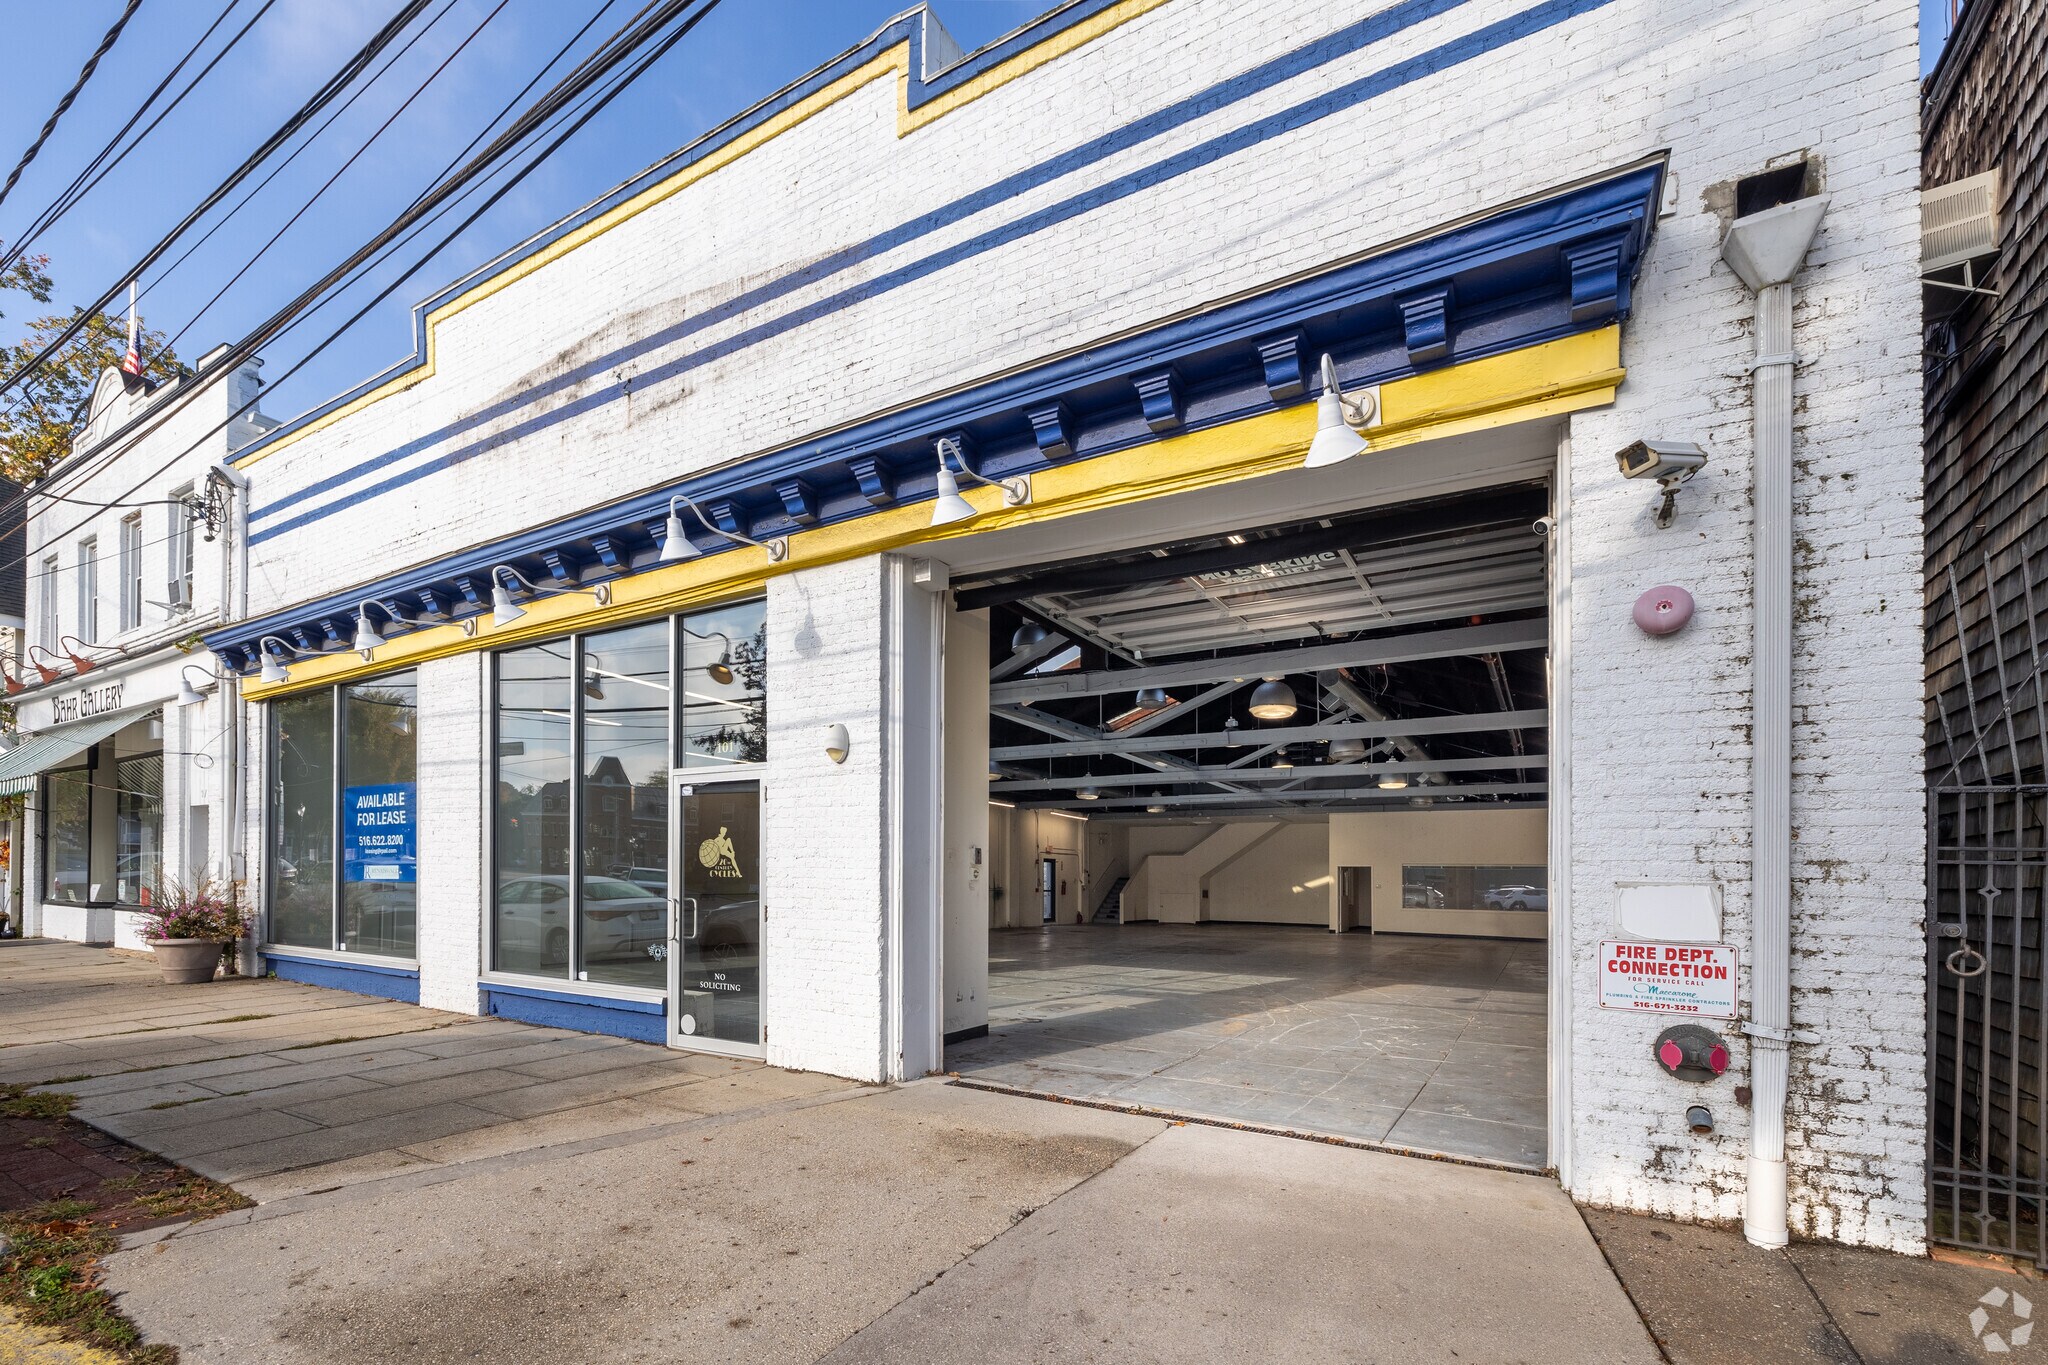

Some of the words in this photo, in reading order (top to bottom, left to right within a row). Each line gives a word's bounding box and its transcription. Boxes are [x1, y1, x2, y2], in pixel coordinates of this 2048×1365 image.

[81, 684, 123, 717] GALLERY
[717, 741, 734, 754] 101
[357, 792, 405, 809] AVAILABLE
[357, 812, 375, 826] FOR
[377, 811, 406, 825] LEASE
[358, 835, 403, 846] 516.622.8200
[1616, 945, 1656, 960] FIRE
[1665, 947, 1718, 963] DEPT.
[1608, 960, 1727, 980] CONNECTION
[700, 981, 741, 991] SOLICITING
[1647, 977, 1680, 985] SERVICE
[1633, 983, 1697, 998] Maccarone
[1633, 1001, 1699, 1012] 516-671-3232
